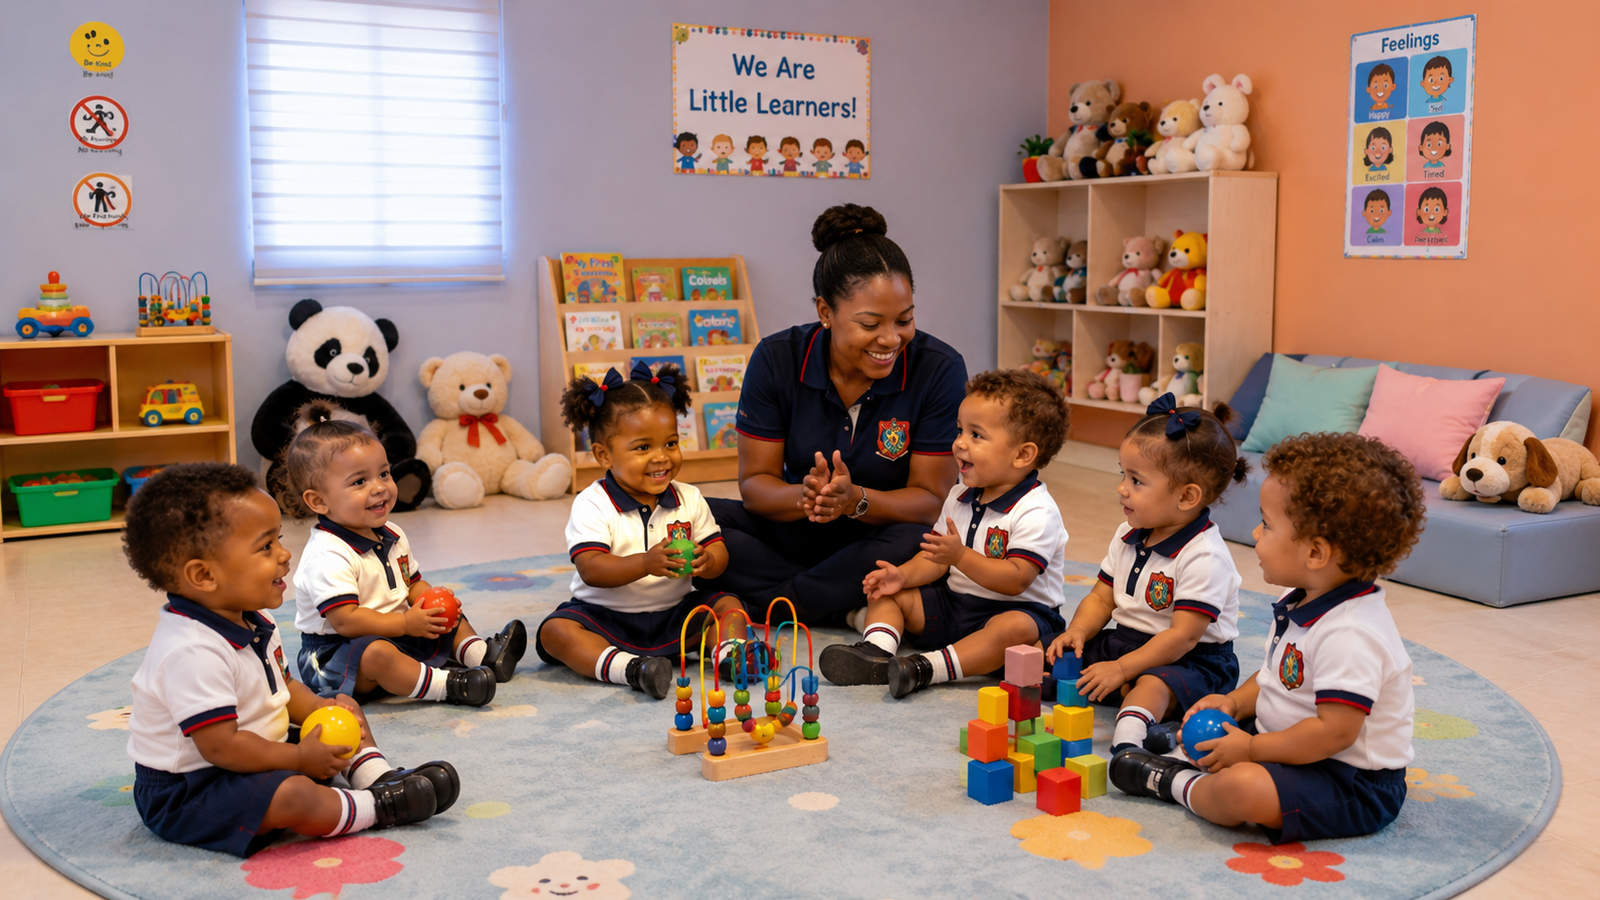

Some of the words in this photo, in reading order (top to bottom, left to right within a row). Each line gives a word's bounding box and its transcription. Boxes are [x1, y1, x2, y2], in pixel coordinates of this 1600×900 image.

[1381, 32, 1440, 53] Feelings
[732, 53, 768, 78] We
[776, 56, 815, 80] Are
[689, 88, 748, 114] Little
[757, 92, 857, 119] Learners!
